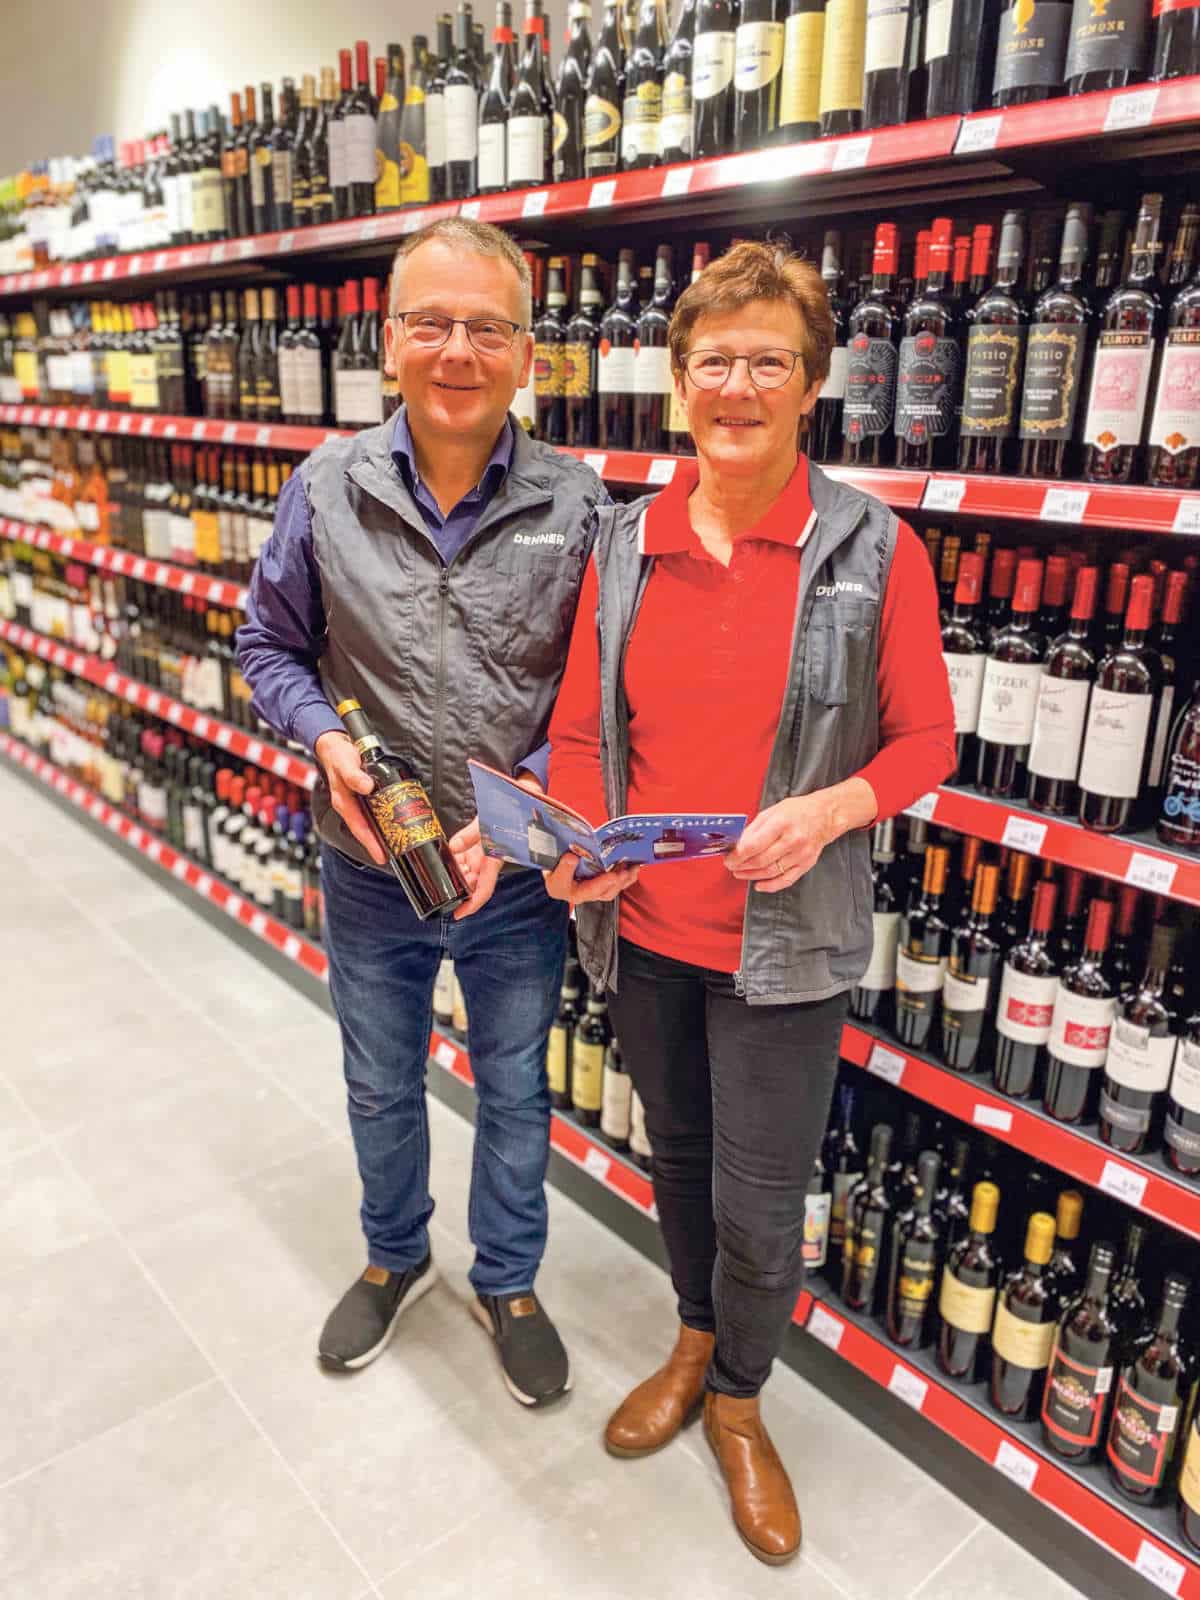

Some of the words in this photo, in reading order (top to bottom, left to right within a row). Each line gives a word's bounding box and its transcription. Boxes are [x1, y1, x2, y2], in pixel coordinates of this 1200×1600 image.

[1103, 335, 1143, 345] HARDYS
[513, 533, 565, 545] DENNER
[607, 819, 662, 834] Wine
[671, 818, 735, 828] Guide
